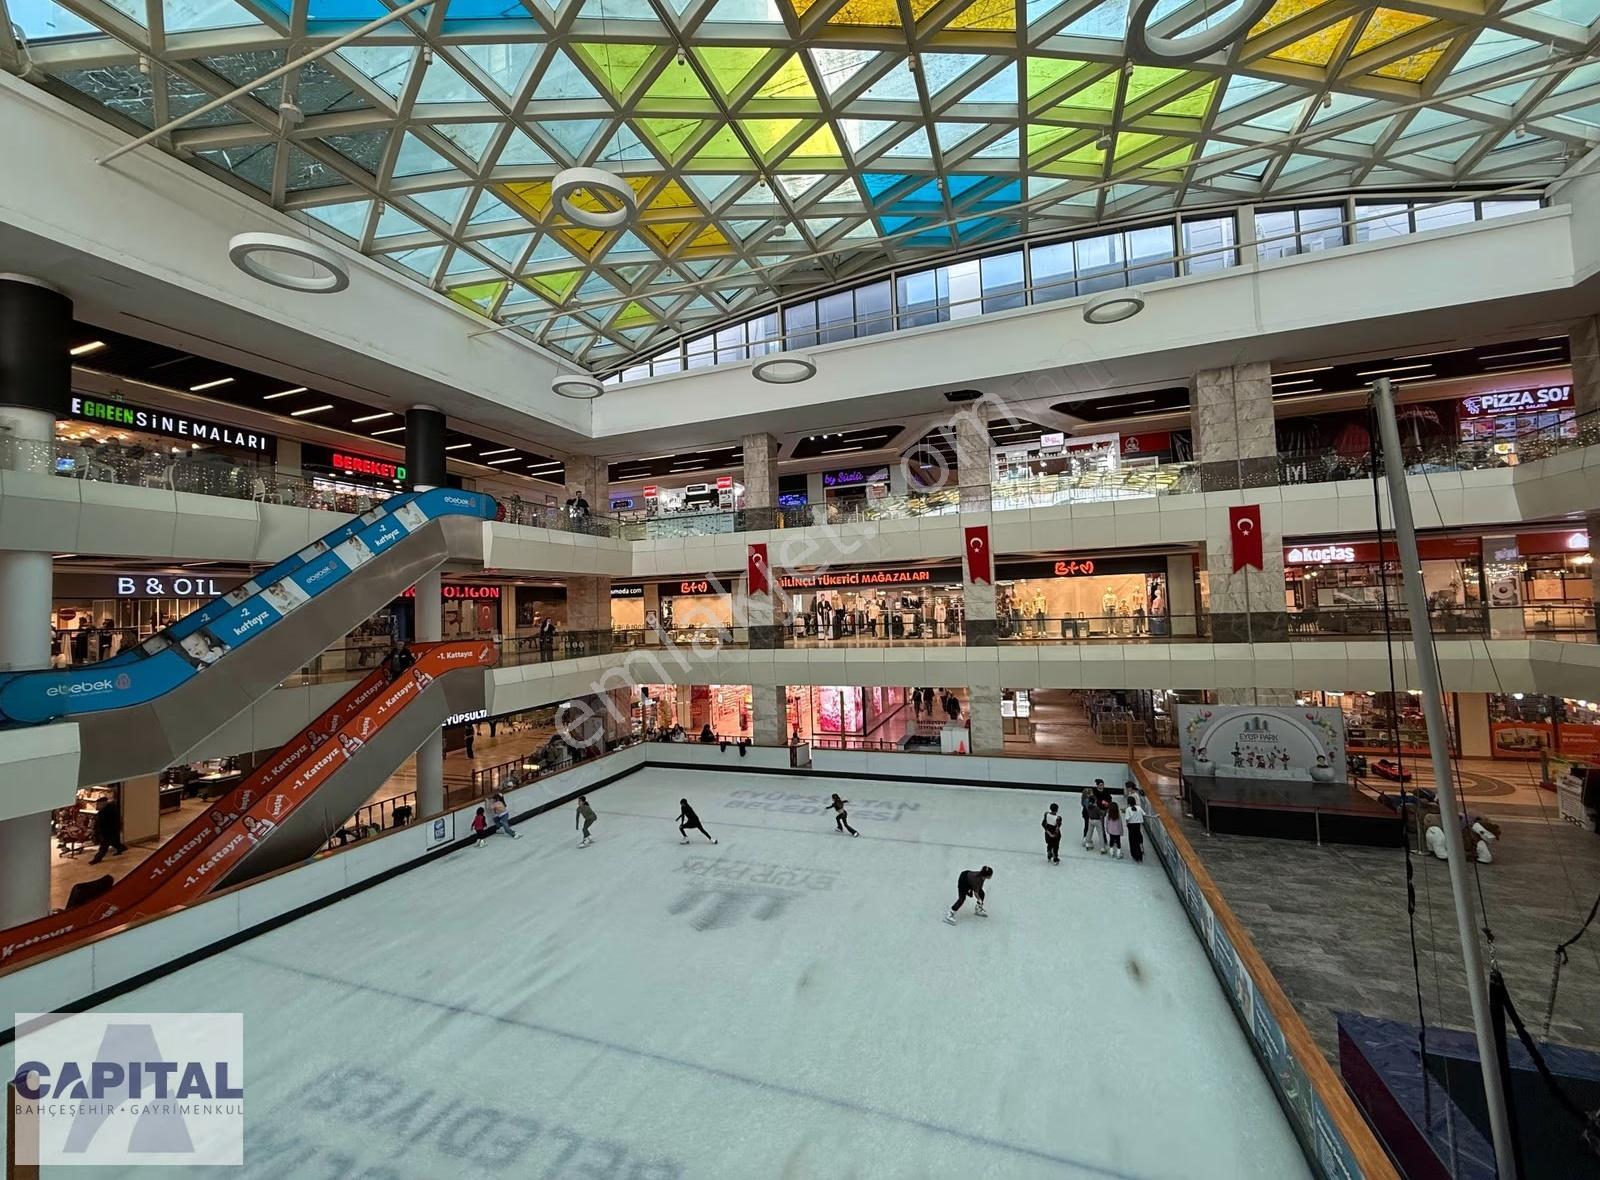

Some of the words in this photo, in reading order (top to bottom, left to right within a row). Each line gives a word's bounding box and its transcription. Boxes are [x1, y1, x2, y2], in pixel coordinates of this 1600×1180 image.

[1537, 386, 1570, 402] SO!
[825, 474, 836, 485] by
[118, 577, 136, 594] B
[146, 577, 165, 594] &
[173, 578, 222, 595] OIL
[818, 574, 859, 585] TÜKETİCİ
[861, 571, 929, 583] MAĞAZALARI
[443, 586, 499, 598] OLIGON
[240, 607, 251, 618] -2
[233, 611, 270, 636] kattayız
[385, 681, 415, 708] Kattayız
[271, 744, 308, 776] Kattayız
[293, 779, 305, 790] -1.
[303, 746, 340, 780] Kattayız
[164, 827, 211, 867] Kattayız
[183, 876, 200, 888] -1.
[196, 833, 245, 875] Kattayız
